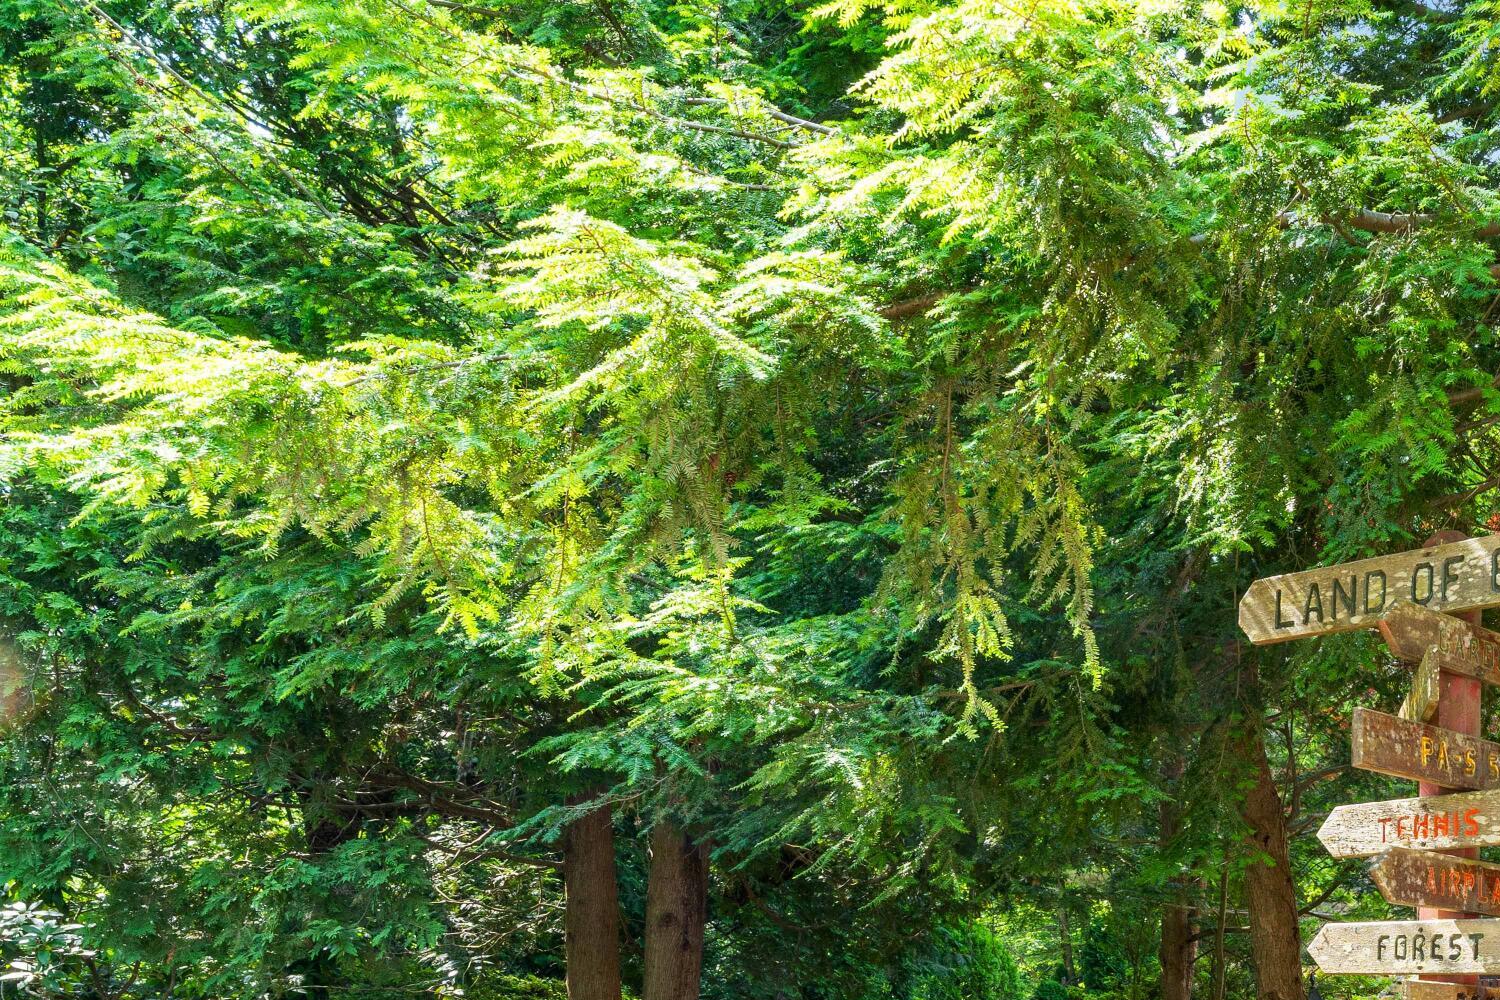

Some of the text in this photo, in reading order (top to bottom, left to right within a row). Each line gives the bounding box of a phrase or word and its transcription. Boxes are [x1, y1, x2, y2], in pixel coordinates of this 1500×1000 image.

[1273, 569, 1388, 630] LAND
[1410, 554, 1466, 607] OF
[1377, 807, 1481, 843] TENNIS
[1377, 932, 1485, 962] FOREST
